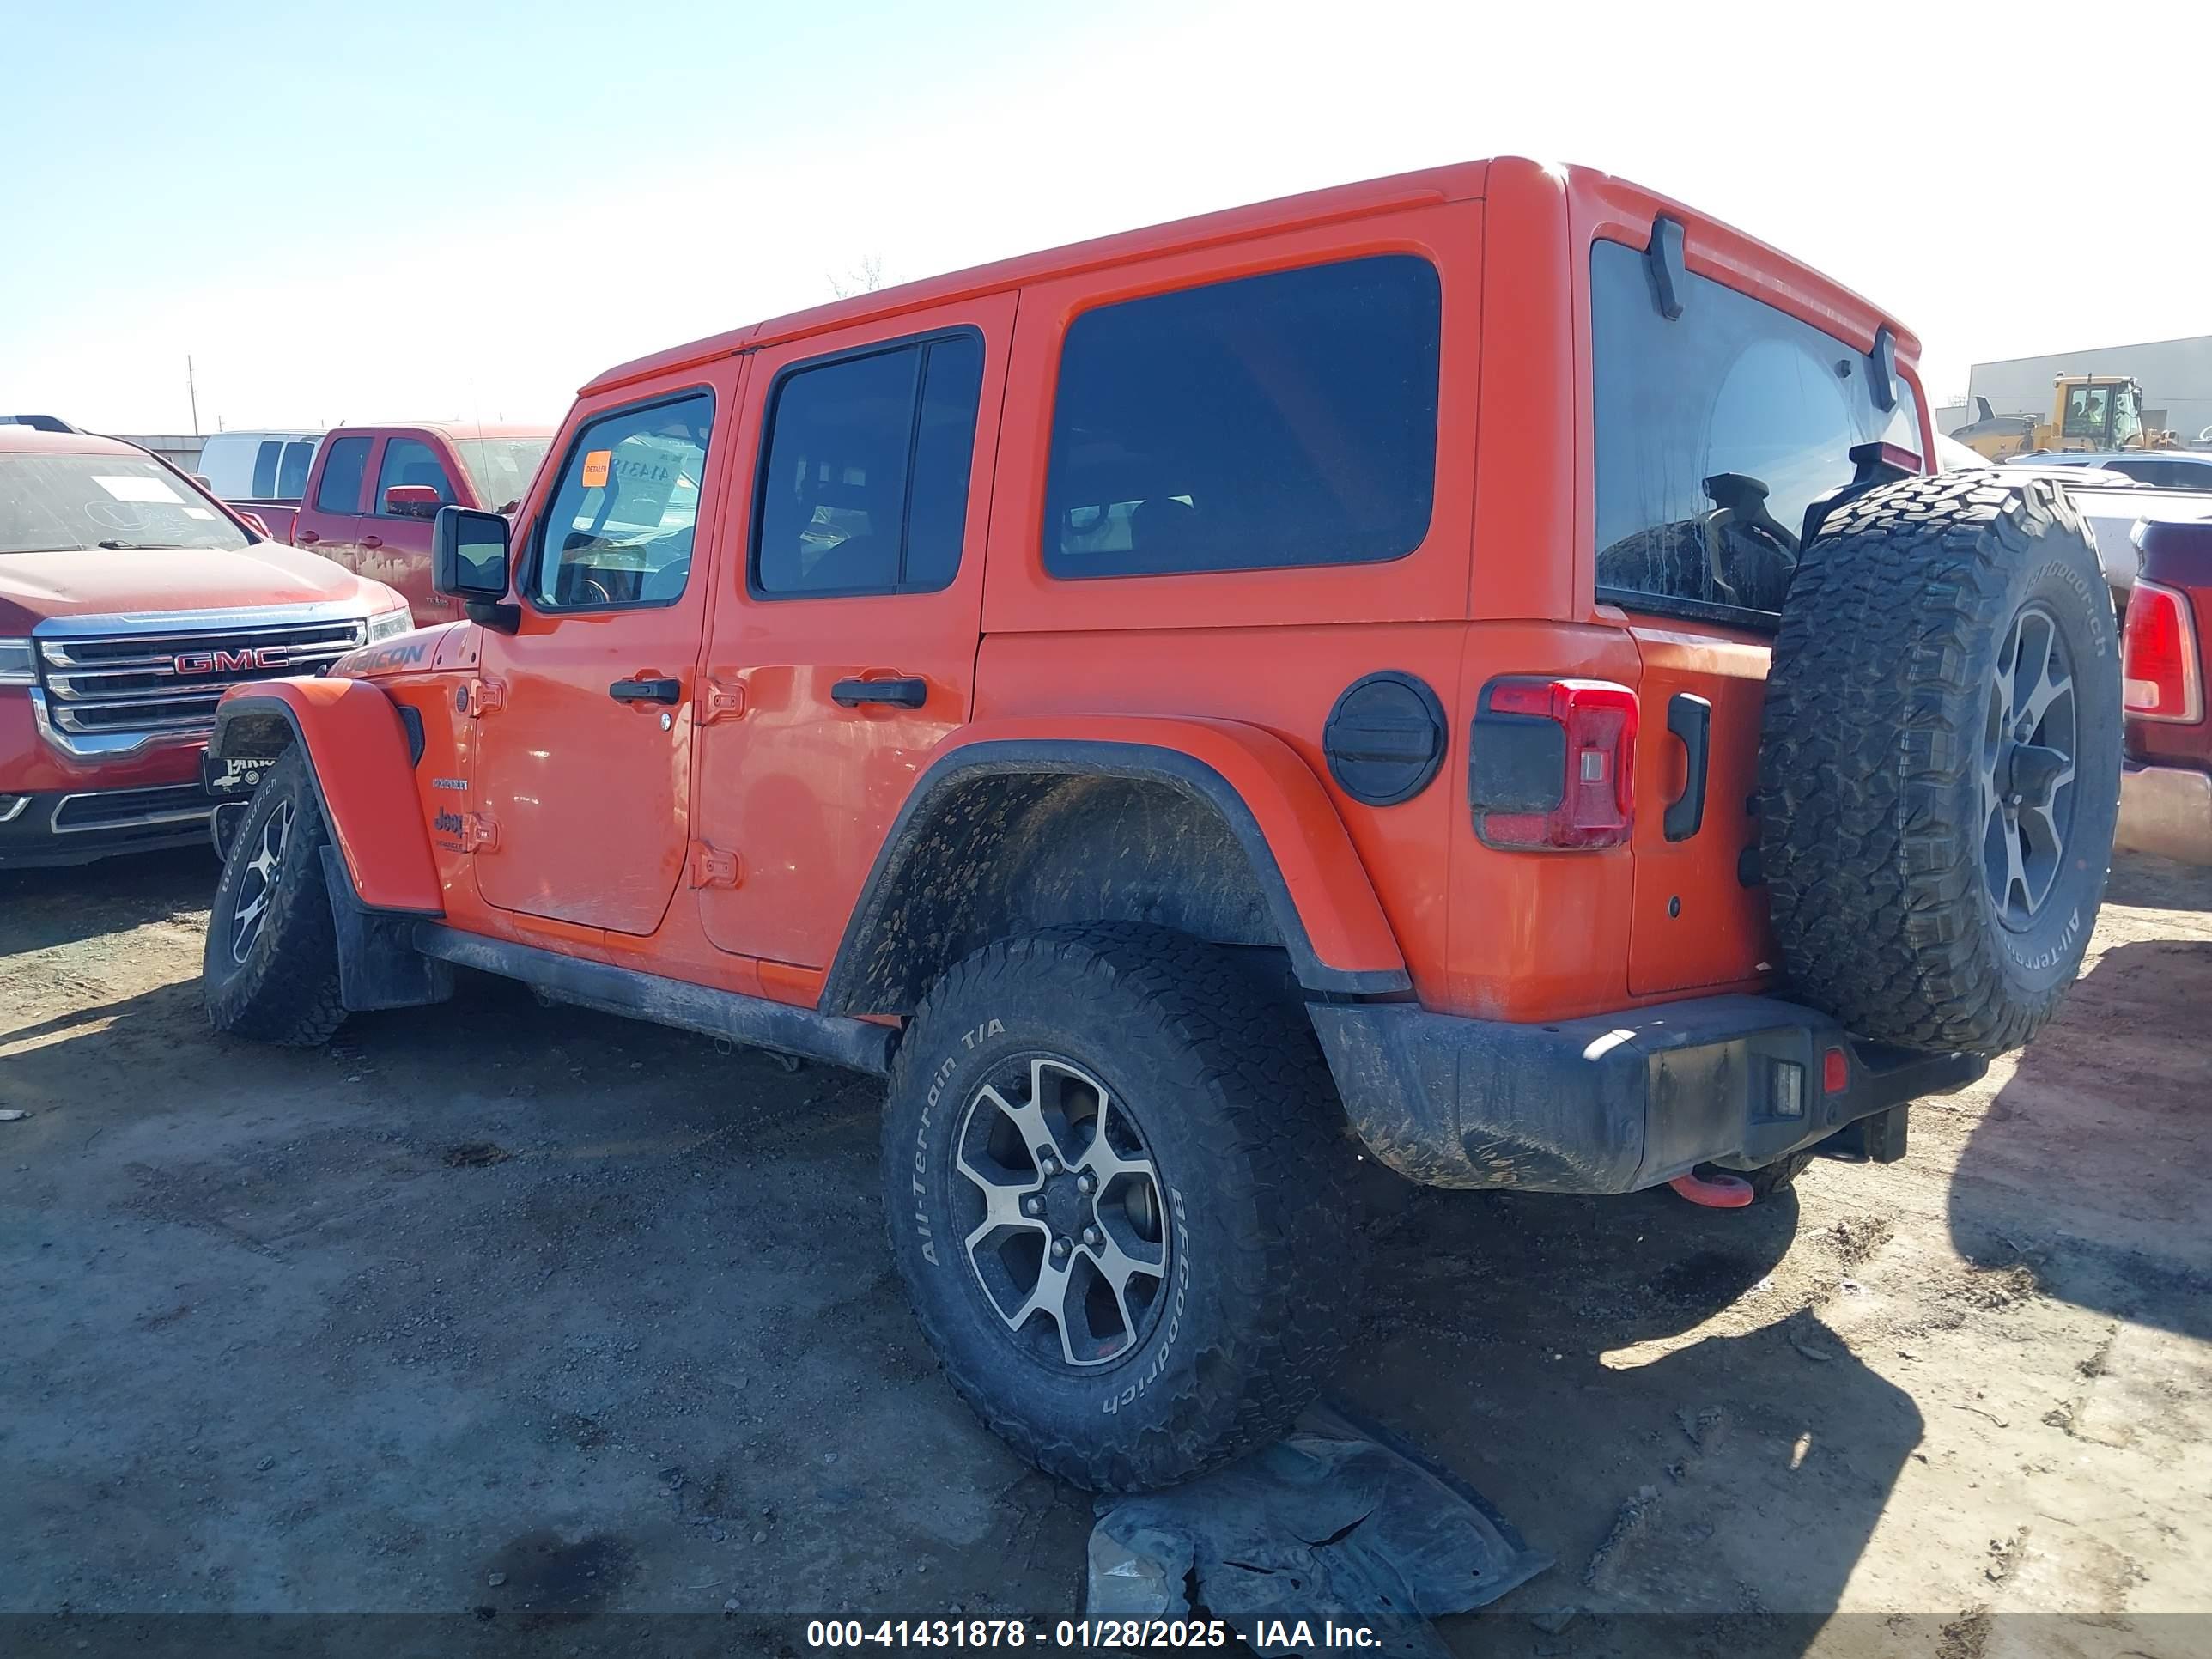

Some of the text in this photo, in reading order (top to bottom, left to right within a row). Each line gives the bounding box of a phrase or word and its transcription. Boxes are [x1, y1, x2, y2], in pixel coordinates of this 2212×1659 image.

[173, 645, 289, 675] GMC
[333, 644, 427, 675] RUBICON
[913, 1016, 1007, 1267] All-Terrain T/A
[1101, 1183, 1192, 1415] BFGoodrich
